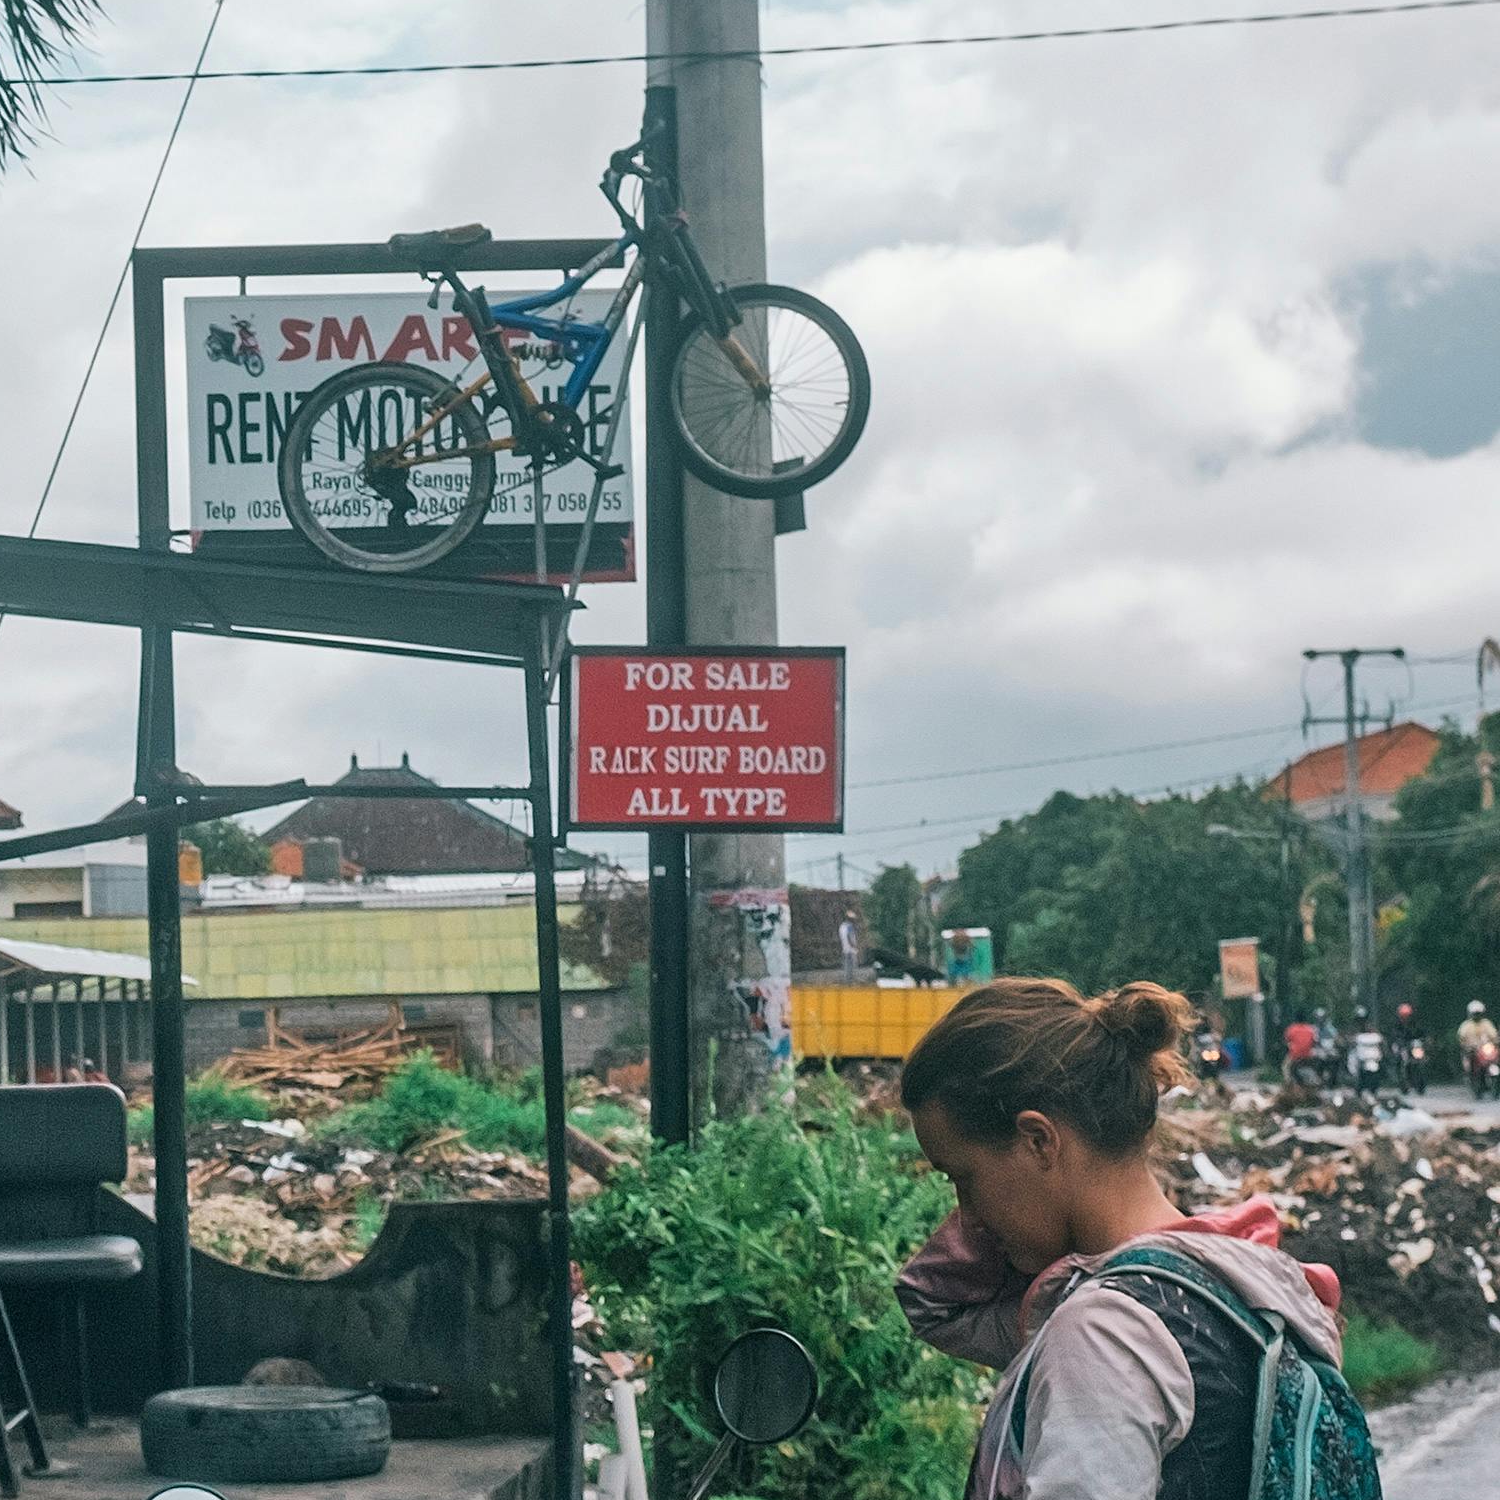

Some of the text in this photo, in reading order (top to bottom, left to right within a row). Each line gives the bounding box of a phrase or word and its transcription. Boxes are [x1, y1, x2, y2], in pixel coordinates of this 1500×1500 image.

[312, 472, 351, 493] Raya
[205, 500, 236, 524] Telp
[304, 499, 372, 518] 444695
[558, 492, 587, 511] 058
[624, 662, 792, 692] FOR SALE
[646, 704, 769, 733] DIJUAL
[589, 745, 827, 775] RACK SURF BOARD
[626, 787, 788, 818] ALL TYPE
